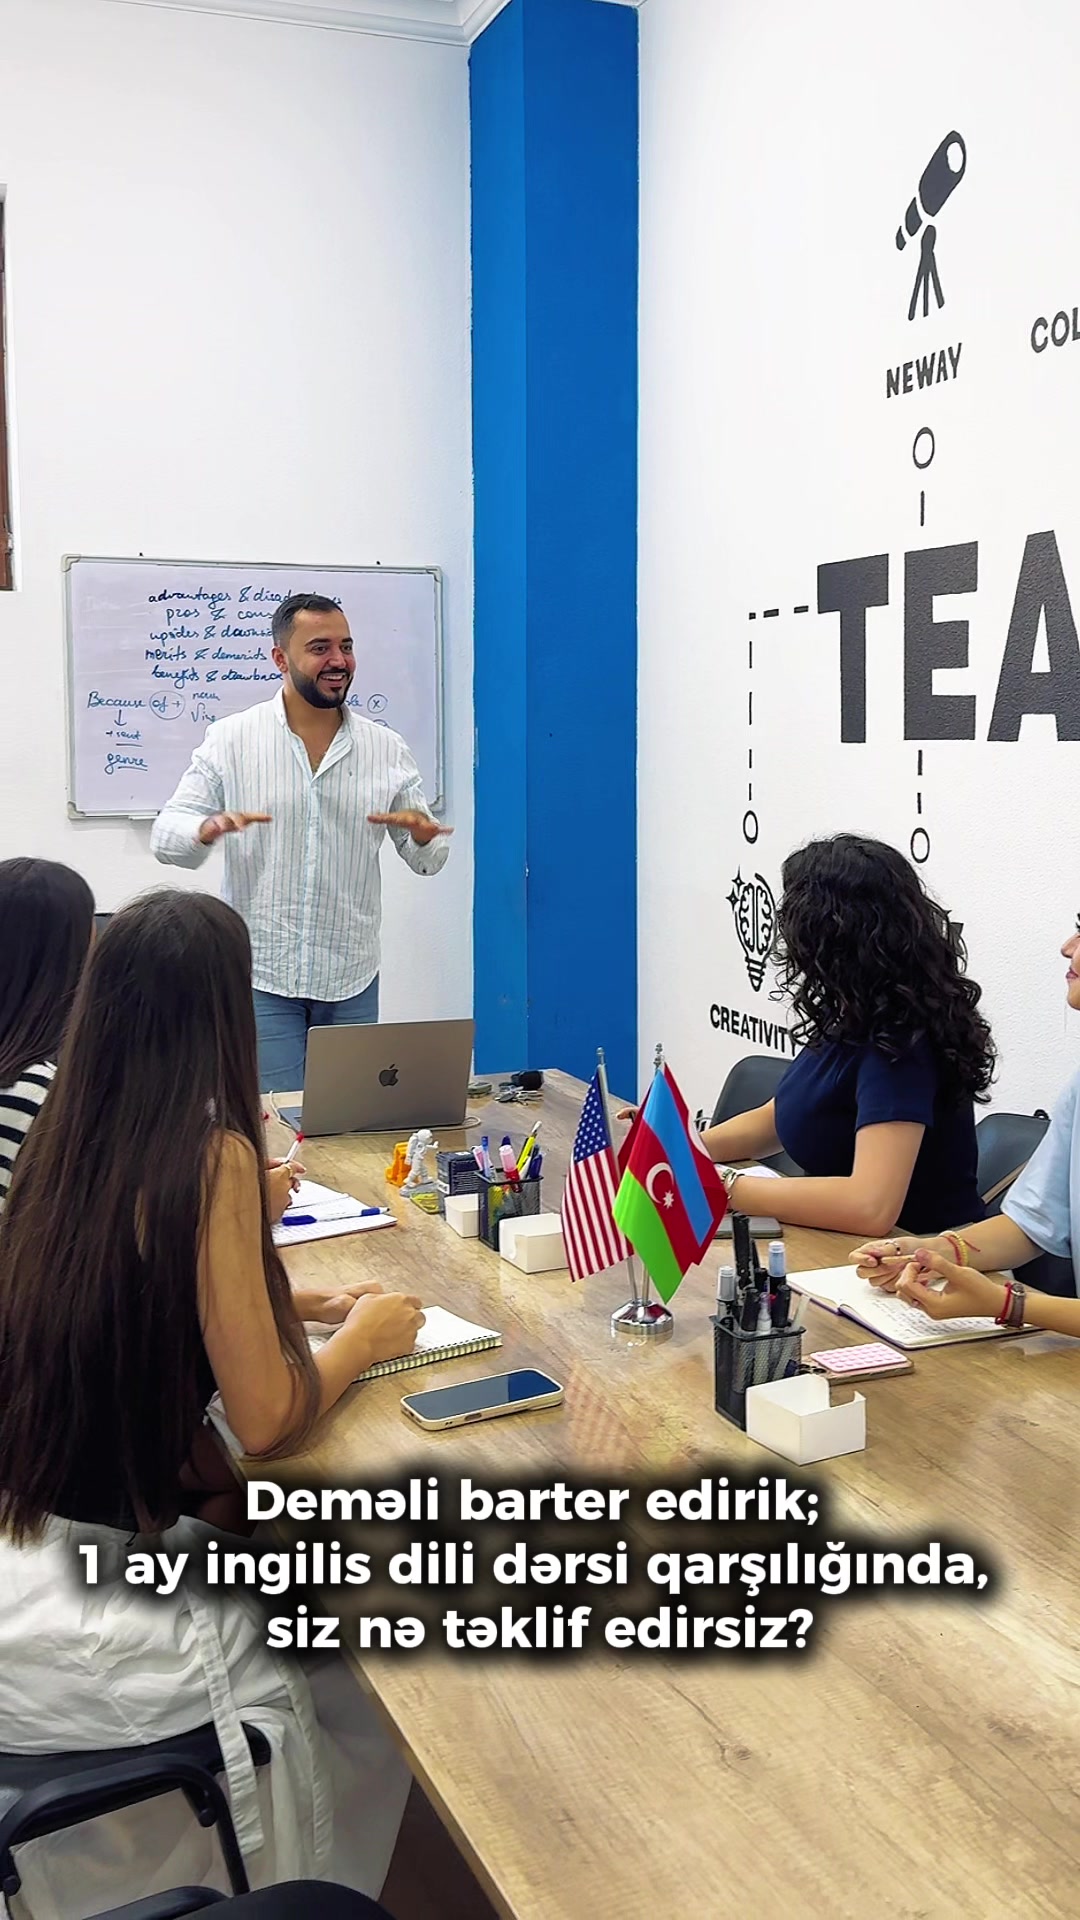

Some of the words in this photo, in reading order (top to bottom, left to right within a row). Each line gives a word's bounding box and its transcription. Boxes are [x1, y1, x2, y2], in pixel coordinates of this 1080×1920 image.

[886, 342, 962, 399] NEWAY
[148, 586, 231, 609] advantages
[238, 585, 252, 602] &
[166, 608, 200, 626] pros
[210, 608, 226, 621] &
[150, 625, 200, 647] upsides
[203, 625, 217, 640] &
[145, 645, 187, 662] merits
[194, 647, 210, 661] &
[211, 646, 268, 661] demerits
[151, 664, 200, 690] benefits
[205, 670, 219, 682] &
[87, 691, 147, 709] Because
[152, 696, 168, 713] of
[104, 753, 149, 775] genre
